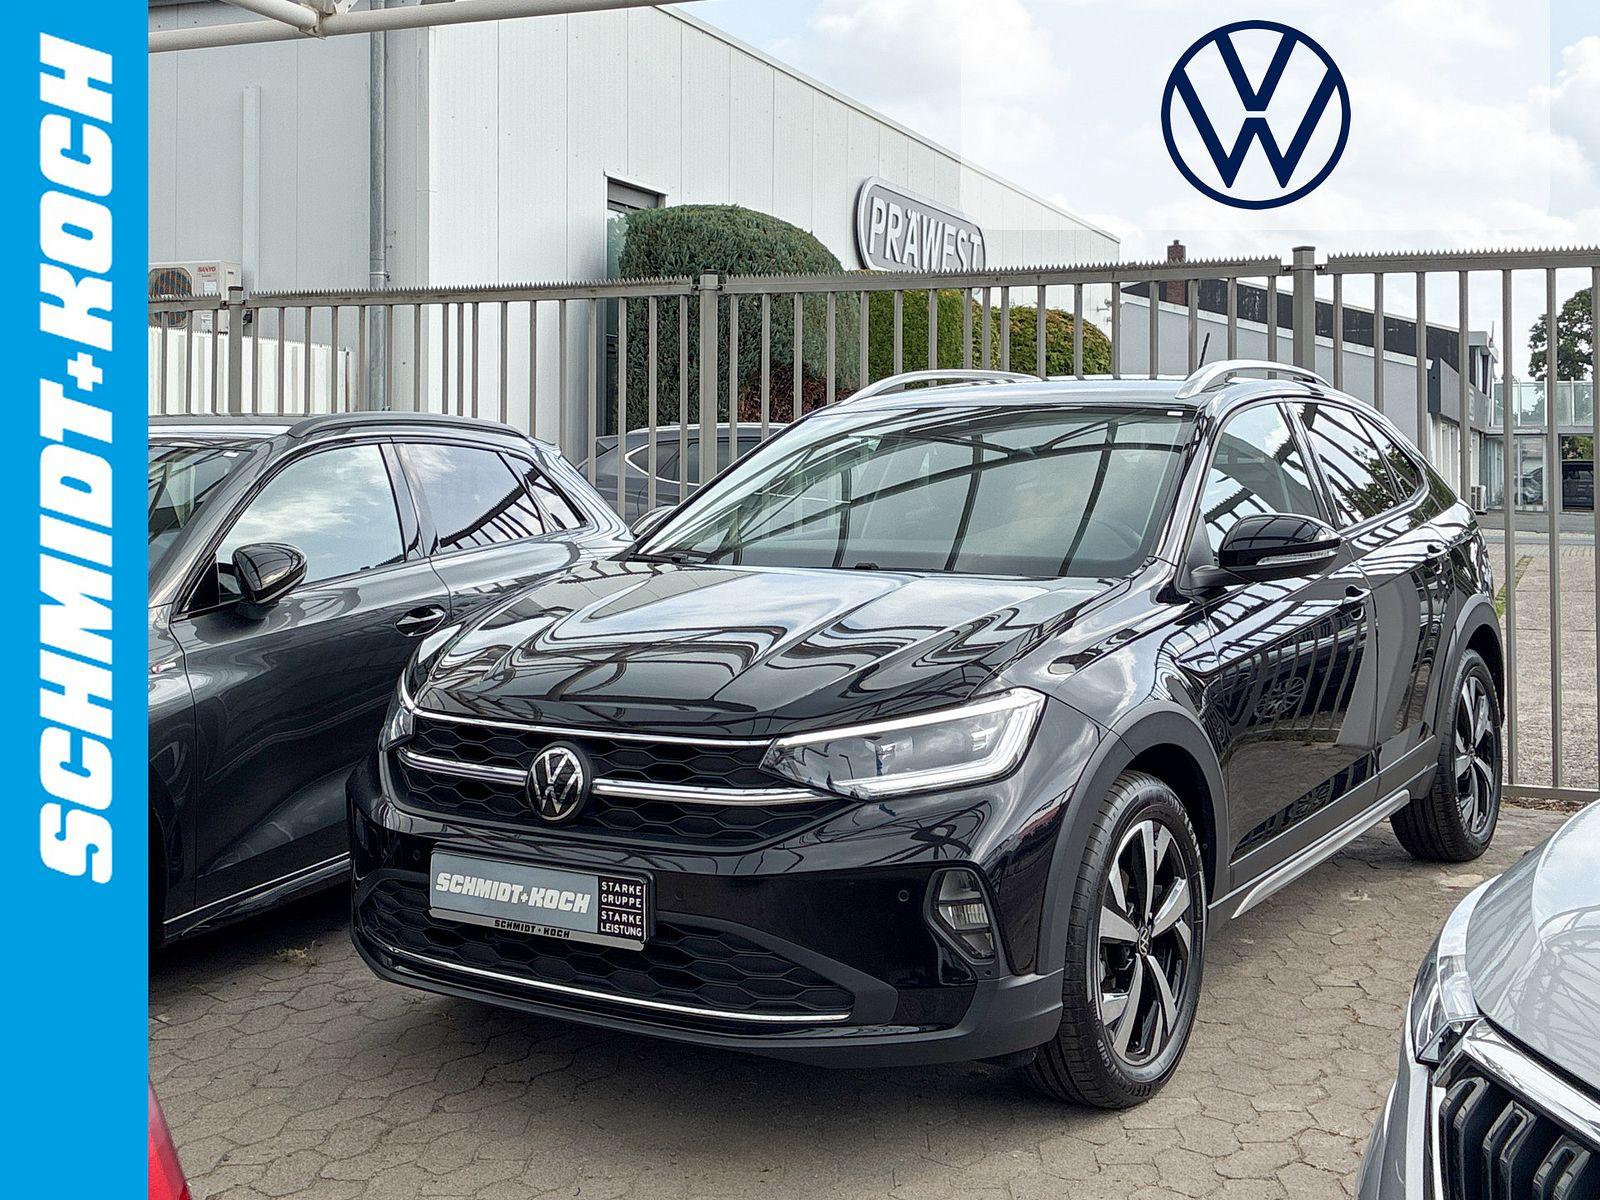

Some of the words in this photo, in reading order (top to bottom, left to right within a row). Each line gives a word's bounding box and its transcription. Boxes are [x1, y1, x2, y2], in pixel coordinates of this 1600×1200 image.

[868, 196, 982, 271] PRÄWEST
[435, 872, 592, 914] SCHMIDT+KOCH
[601, 881, 642, 896] STARKE
[601, 893, 642, 908] GRUPPE
[601, 910, 642, 925] STARKE
[543, 927, 571, 939] KOCH
[600, 922, 642, 937] LEISTUNG
